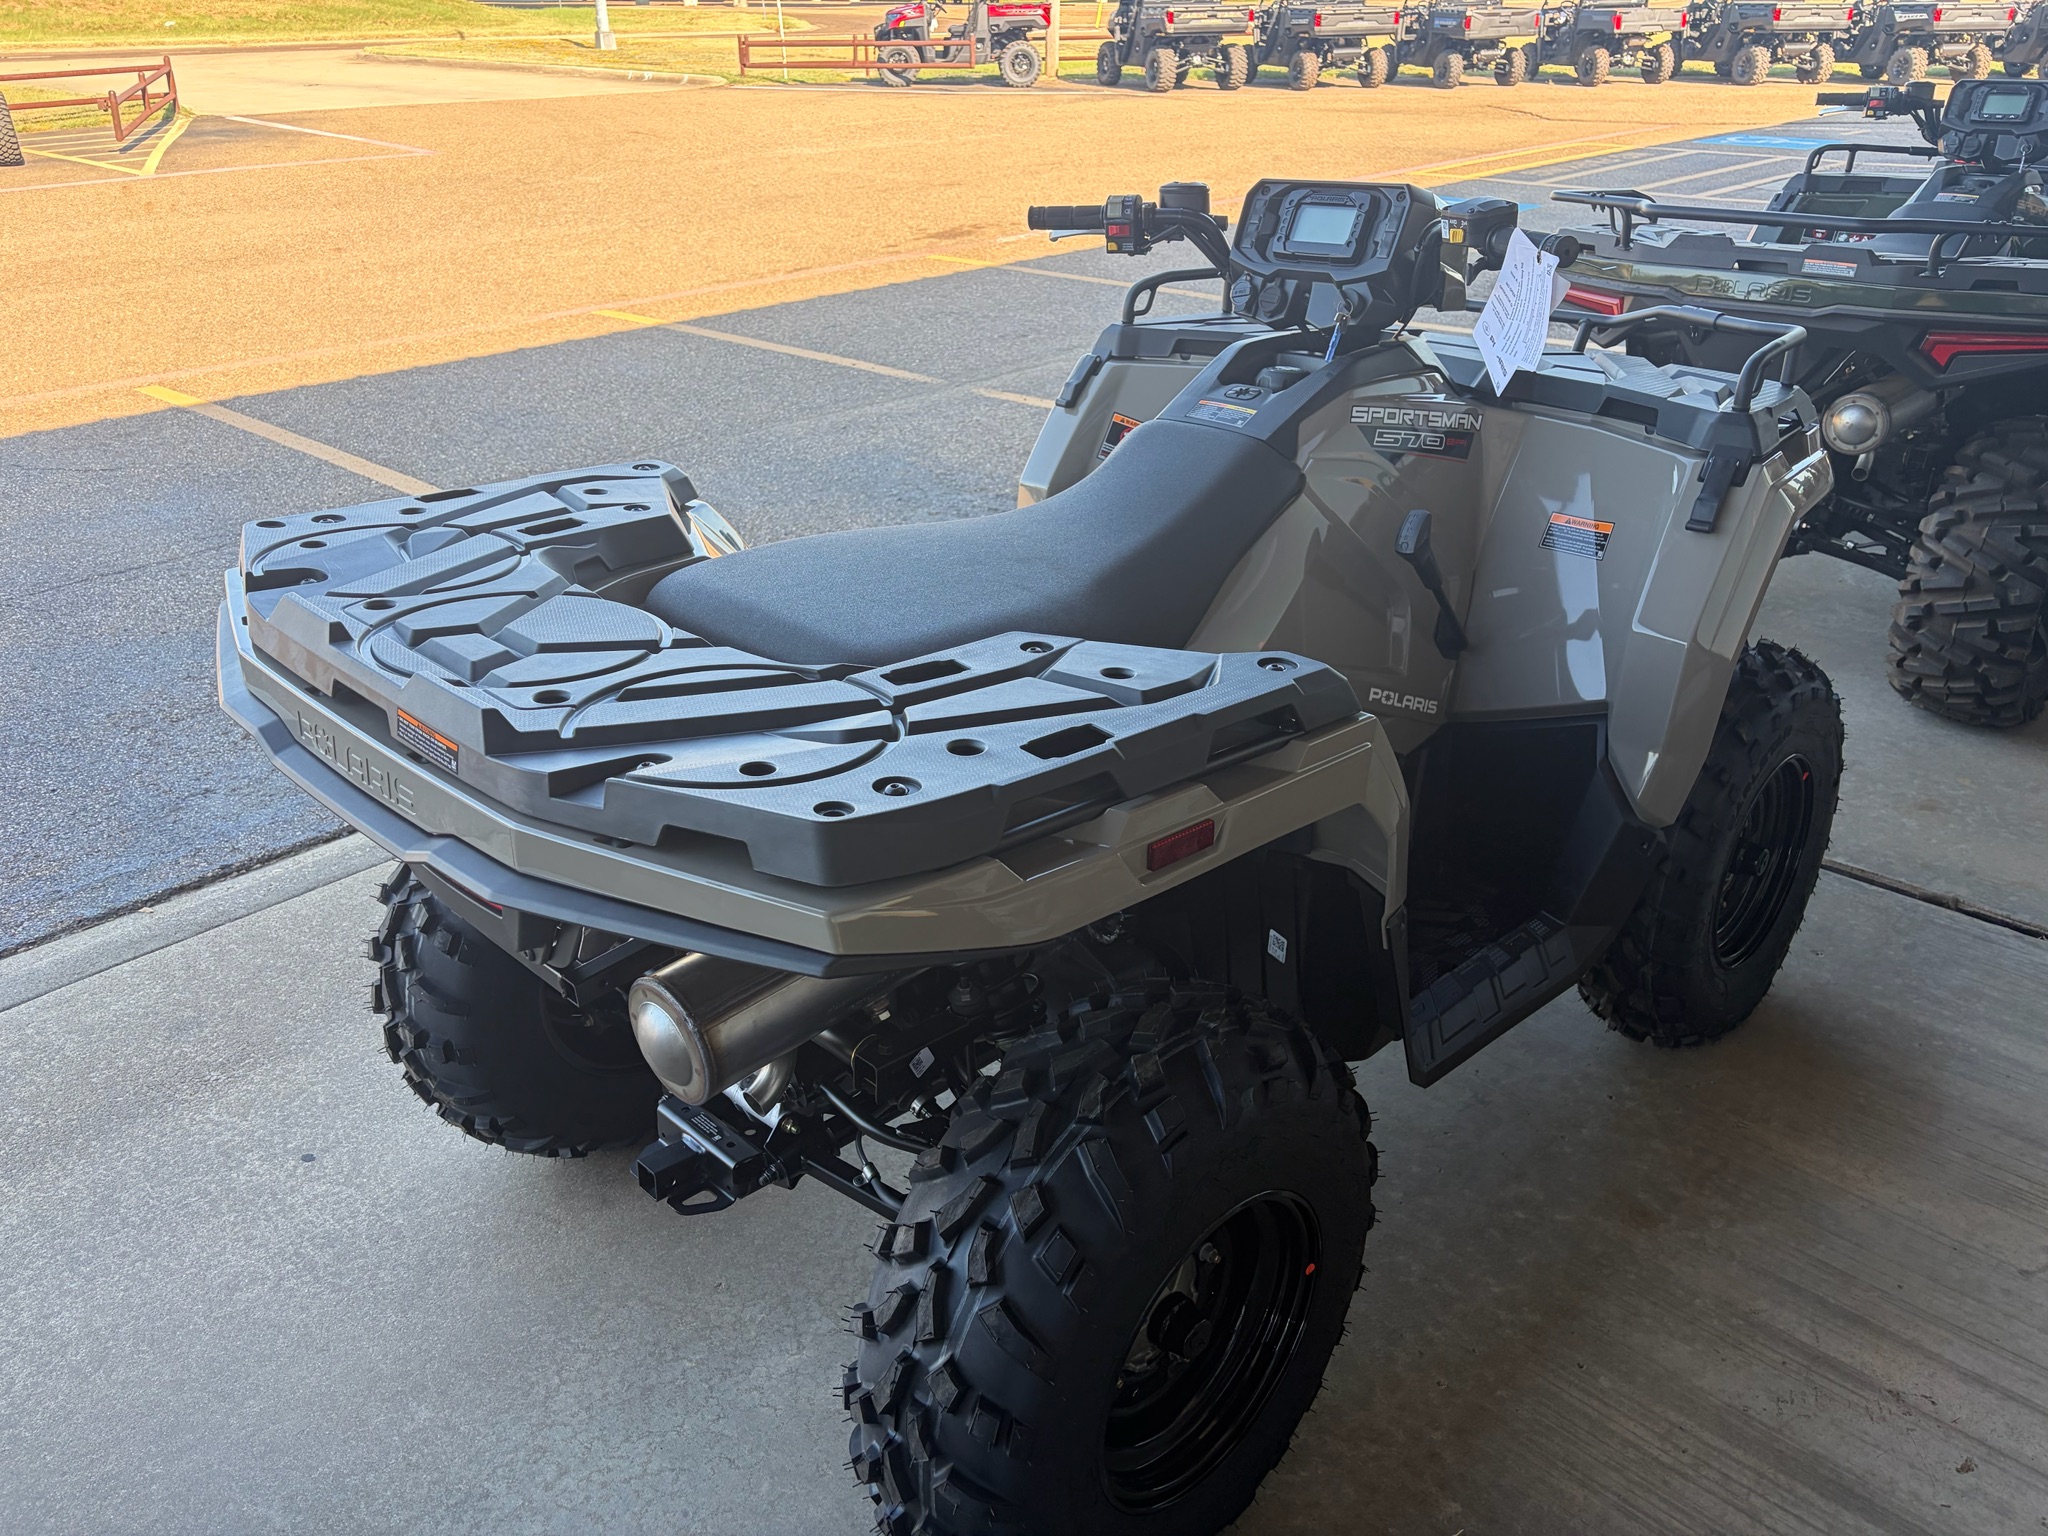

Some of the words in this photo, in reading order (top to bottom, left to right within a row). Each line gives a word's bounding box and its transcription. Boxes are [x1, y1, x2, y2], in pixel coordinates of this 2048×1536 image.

[1695, 276, 1811, 303] POLARIS
[1350, 406, 1483, 432] SPORTSMAN
[1373, 429, 1446, 450] 570
[1571, 518, 1600, 530] WARNING
[1368, 687, 1439, 715] POLARIS
[297, 710, 417, 816] POLARIS
